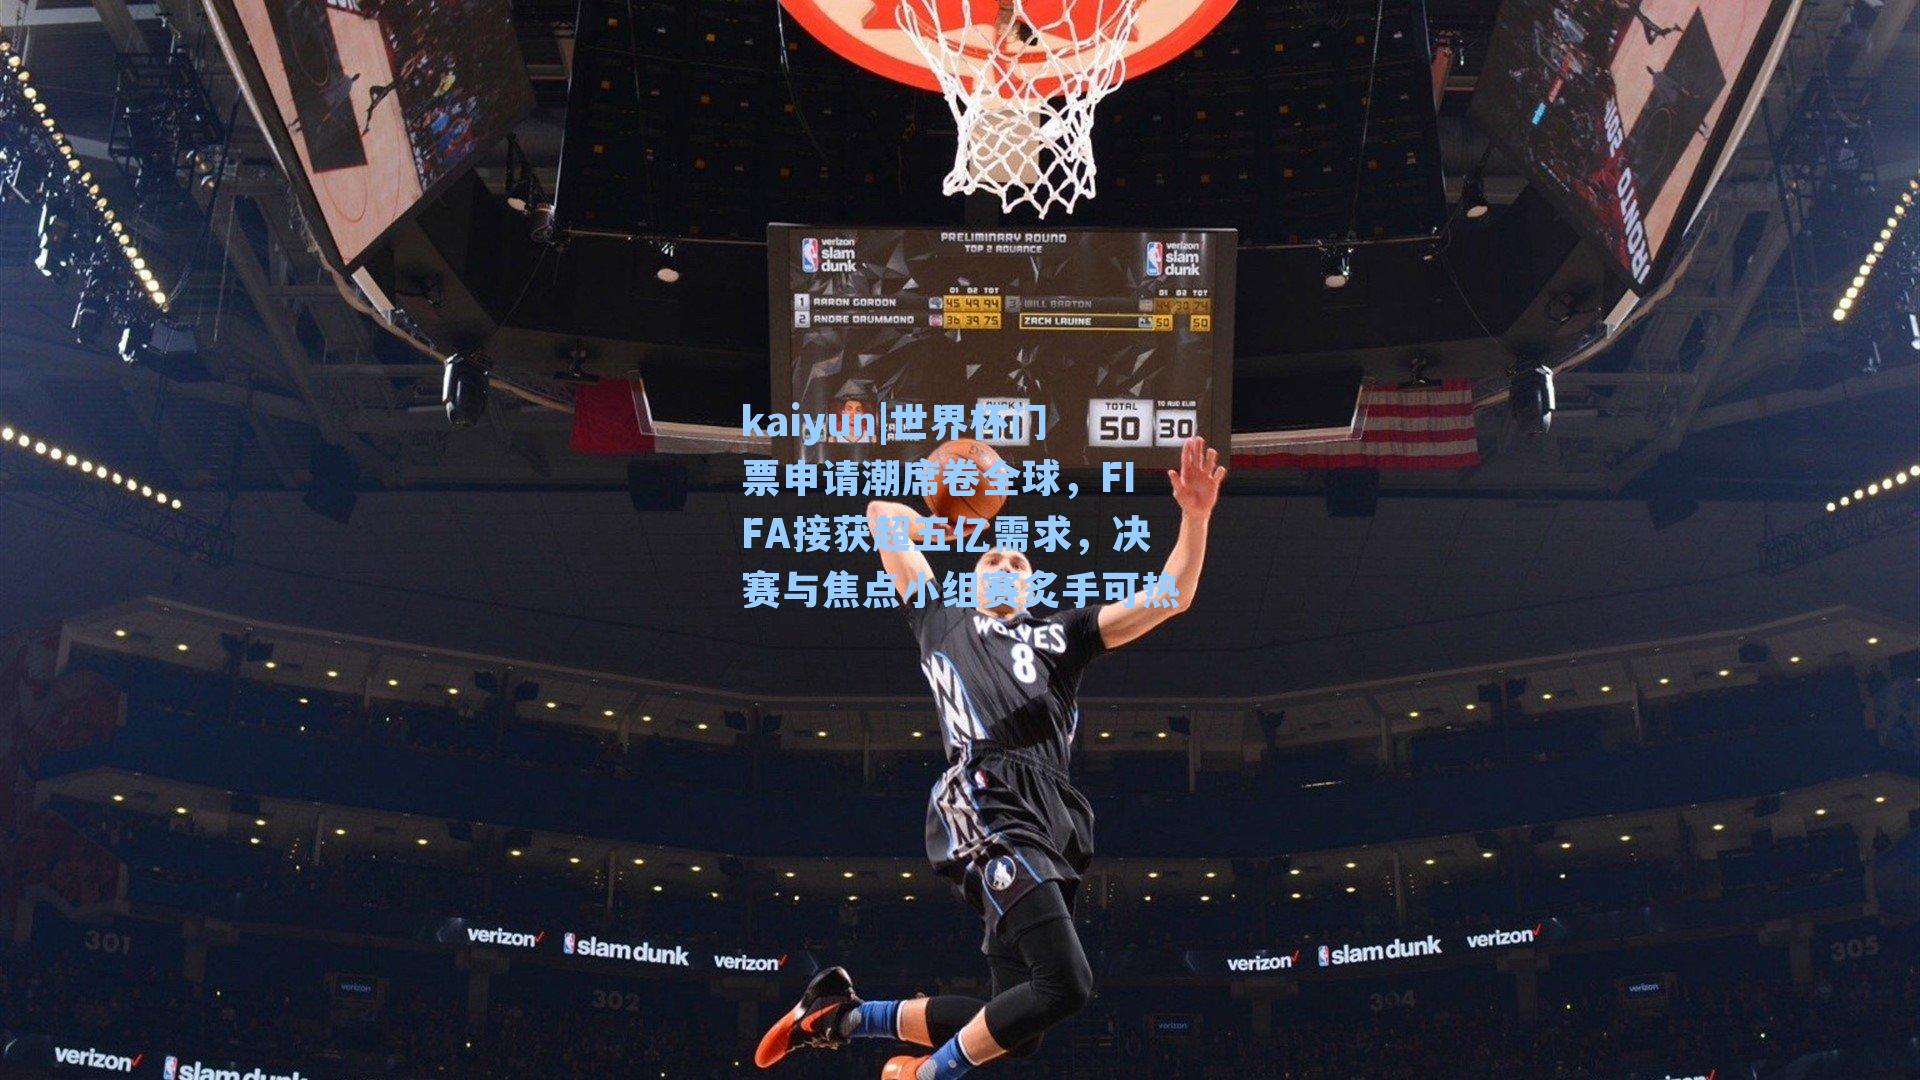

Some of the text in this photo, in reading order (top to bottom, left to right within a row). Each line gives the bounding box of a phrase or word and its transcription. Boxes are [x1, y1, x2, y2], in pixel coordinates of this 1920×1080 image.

[821, 238, 855, 246] verizon
[941, 232, 1067, 243] PRELIMINARY ROUND
[965, 245, 1042, 253] TOP 2 ADVANCE
[1166, 242, 1200, 250] verizon
[821, 247, 855, 259] slam
[1165, 251, 1200, 263] slam
[821, 261, 857, 272] dunk
[1165, 264, 1200, 276] dunk
[813, 298, 850, 307] AARON
[853, 298, 896, 307] GORDON
[947, 298, 960, 308] 45
[965, 298, 979, 308] 49
[984, 298, 999, 308] 94
[813, 315, 850, 324] ANDRE
[852, 315, 915, 324] DRUMMOND
[947, 315, 960, 325] 36
[966, 315, 979, 325] 39
[984, 315, 999, 325] 75
[1024, 317, 1208, 327] ZACH LAVINE 50 50
[1105, 402, 1138, 410] TOTAL
[1100, 416, 1140, 440] 50
[1159, 418, 1194, 438] 30
[1011, 643, 1037, 683] 8
[84, 930, 131, 954] 301
[467, 927, 536, 948] verizon
[1467, 927, 1534, 948] verizon
[577, 936, 690, 966] slam dunk
[1330, 935, 1442, 965] slam dunk
[1830, 935, 1879, 961] 305
[714, 953, 779, 971] verizon
[1227, 952, 1292, 971] verizon
[341, 982, 372, 993] verizon
[1628, 982, 1659, 993] verizon
[593, 990, 640, 1011] 302
[54, 1046, 133, 1072] verizon
